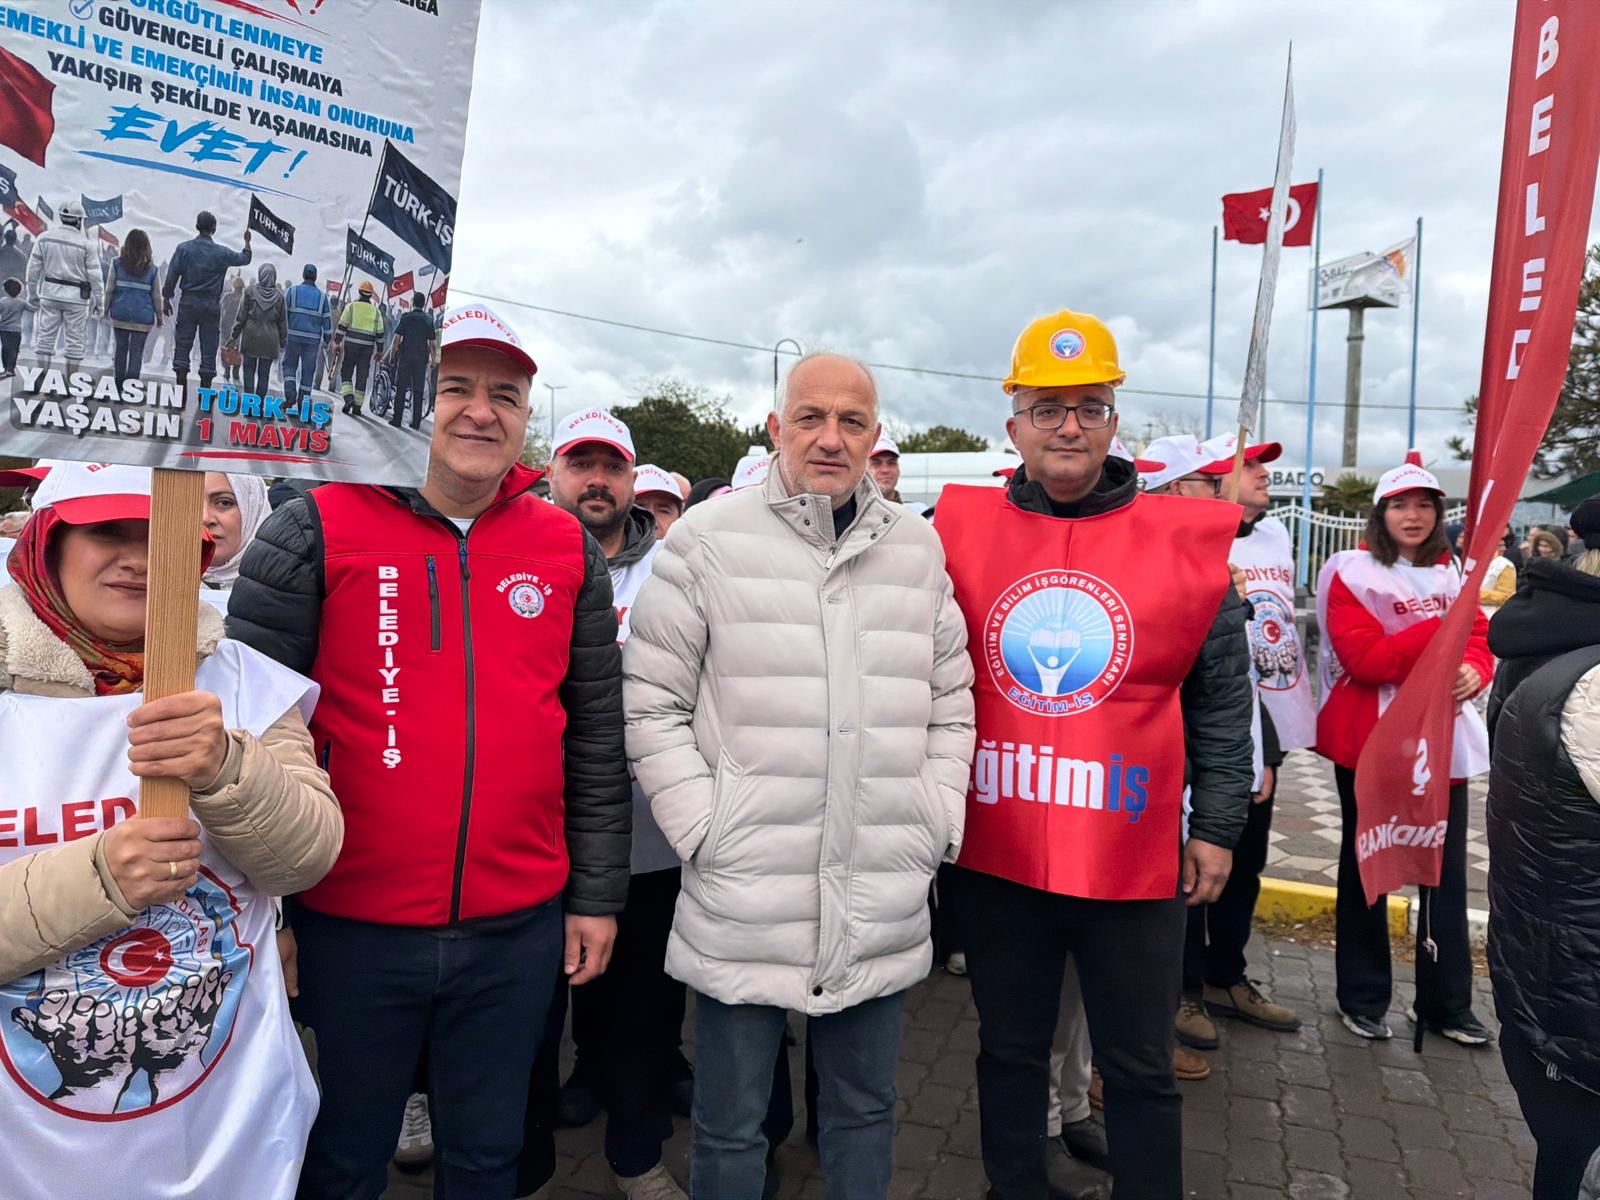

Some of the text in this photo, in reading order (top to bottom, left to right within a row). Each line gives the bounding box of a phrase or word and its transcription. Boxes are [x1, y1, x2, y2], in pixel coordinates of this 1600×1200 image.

[92, 33, 123, 60] VE
[131, 45, 253, 97] EMEKÇİNİN
[260, 79, 321, 116] İNSAN
[327, 104, 415, 144] ONURUNA
[99, 7, 343, 97] GÜVENCELİ ÇALIŞMAYA
[48, 51, 372, 157] YAKIŞIR ŞEKİLDE YAŞAMASINA
[384, 174, 454, 247] TÜRK-İŞ
[13, 397, 329, 452] YAŞASIN 1 MAYIS
[16, 365, 332, 430] YAŞASIN TÜRK-İŞ
[989, 574, 1128, 687] EĞİTİM VE BİLİM İŞGÖRENLERİ SENDİKASI
